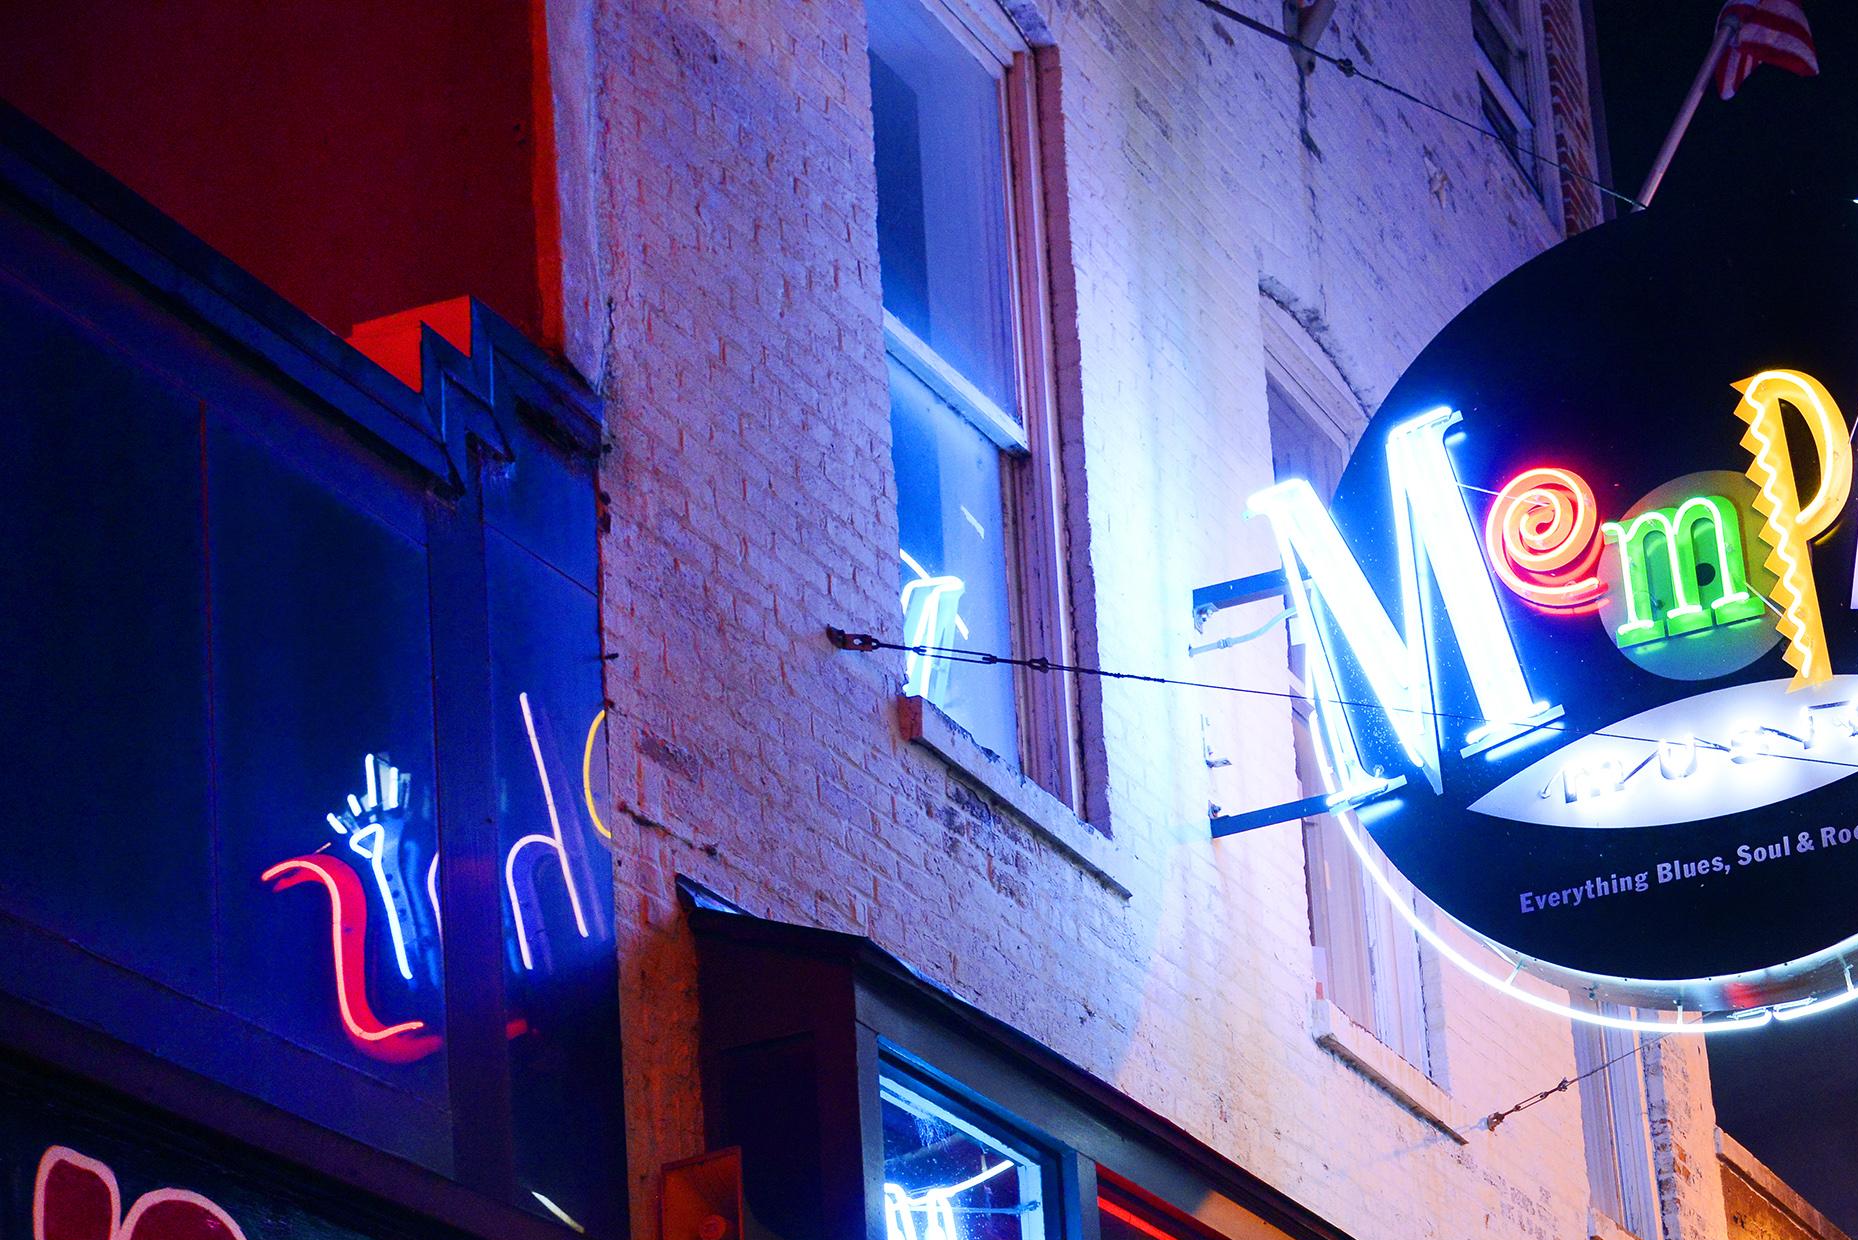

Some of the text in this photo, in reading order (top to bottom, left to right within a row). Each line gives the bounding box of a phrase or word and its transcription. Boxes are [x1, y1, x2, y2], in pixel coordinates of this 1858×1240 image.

[1519, 871, 1650, 914] Everything
[1656, 855, 1732, 885] Blues,
[1736, 835, 1791, 868] Soul
[1795, 831, 1816, 853] &
